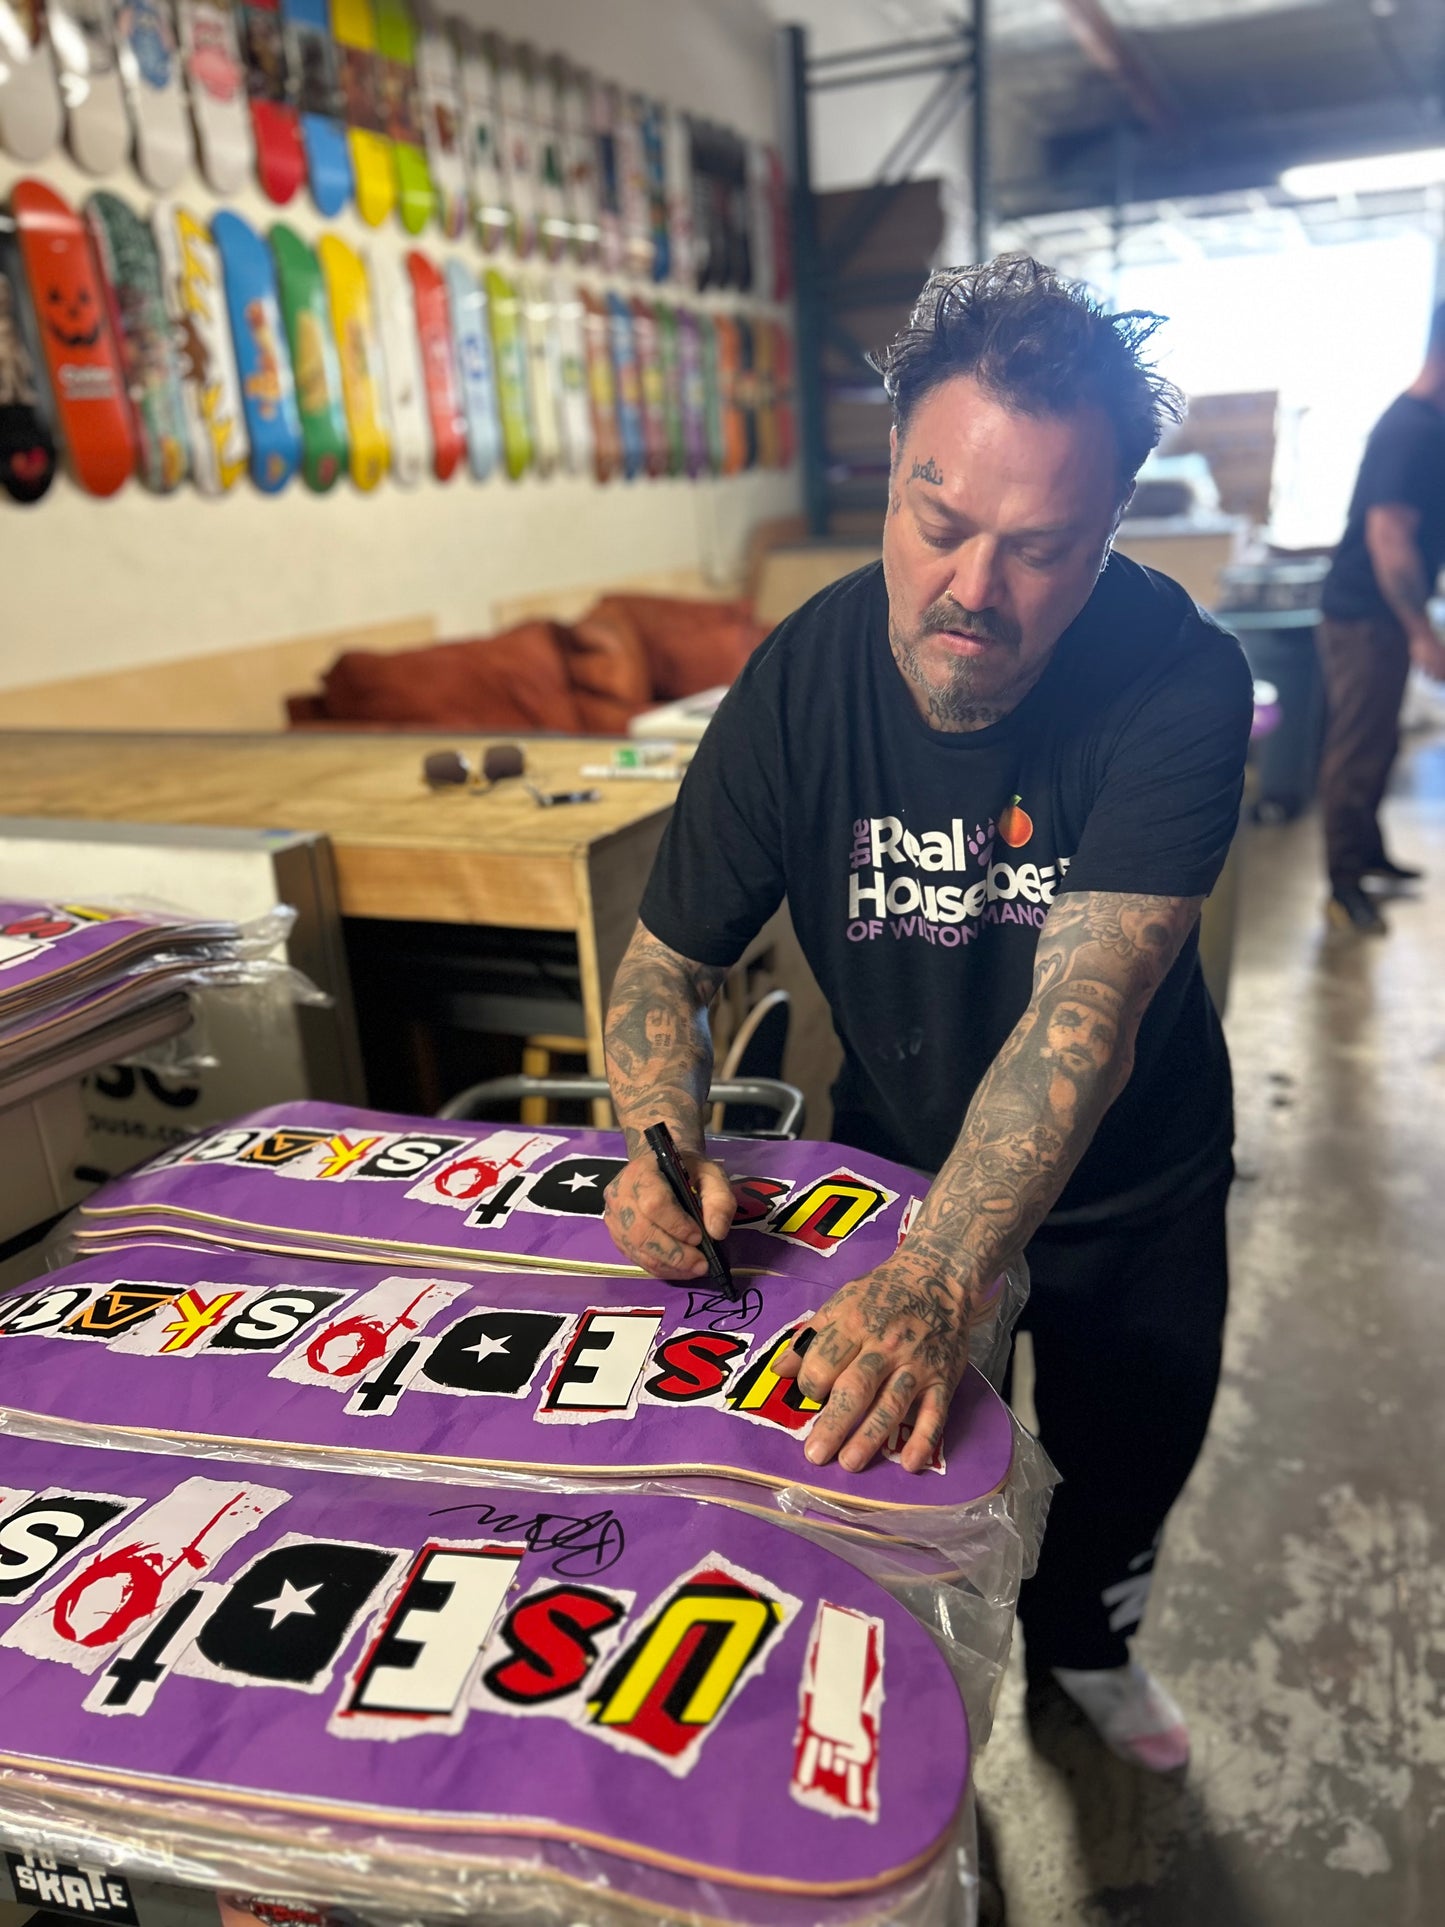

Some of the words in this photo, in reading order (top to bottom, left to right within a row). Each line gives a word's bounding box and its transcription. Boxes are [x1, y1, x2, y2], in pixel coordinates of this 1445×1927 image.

[850, 818, 871, 869] the
[846, 920, 883, 942] OF
[890, 914, 979, 947] WILTON
[980, 902, 1050, 930] MANO
[199, 1543, 784, 1756] USED
[16, 1860, 129, 1912] SKATE
